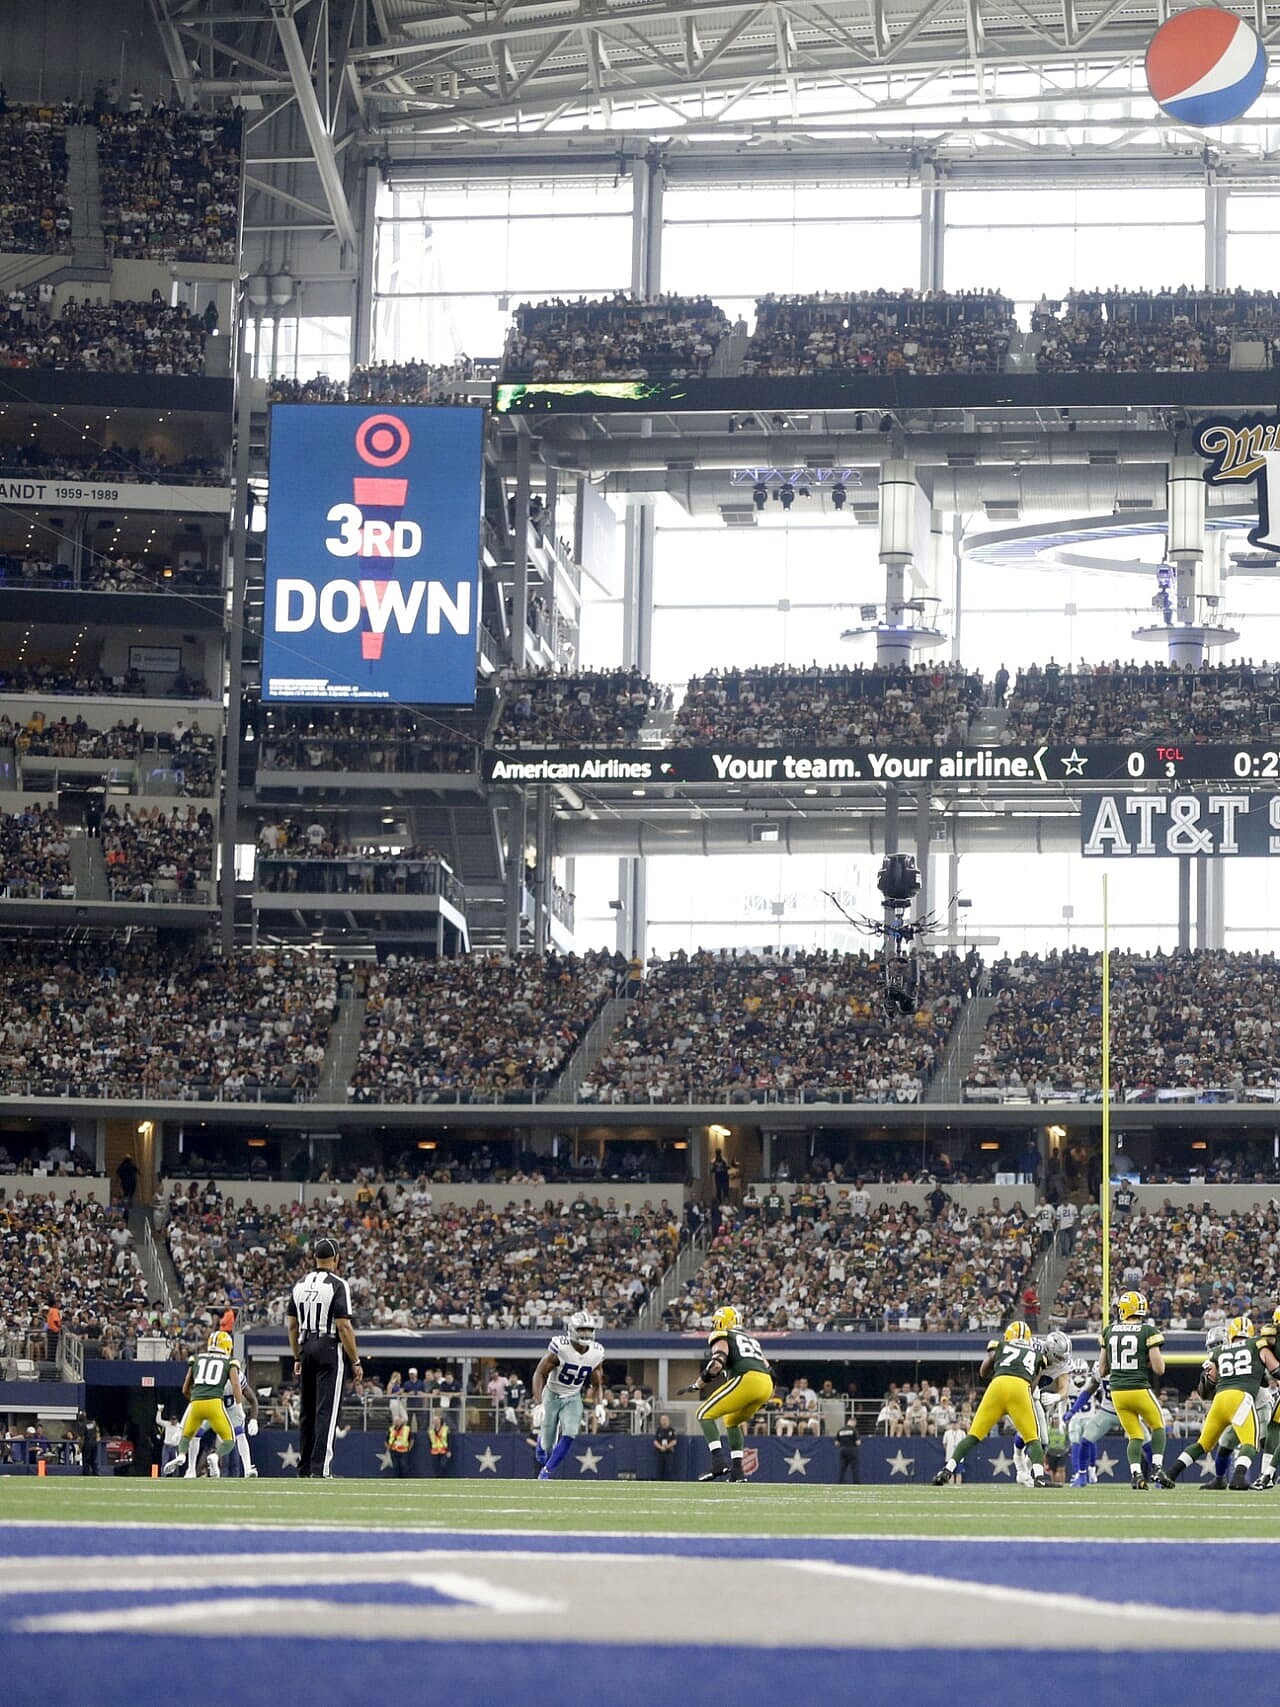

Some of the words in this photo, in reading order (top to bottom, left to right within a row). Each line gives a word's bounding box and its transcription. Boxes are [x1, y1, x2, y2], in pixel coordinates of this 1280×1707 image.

[55, 488, 119, 500] 1959-1989
[325, 503, 422, 558] 3RD
[275, 578, 471, 635] DOWN
[491, 759, 580, 779] American
[581, 759, 652, 778] Airlines
[712, 754, 777, 779] Your
[783, 754, 861, 778] team.
[868, 753, 933, 778] Your
[939, 751, 1034, 778] airline.
[1127, 752, 1145, 777] 0
[1165, 762, 1176, 777] 3
[1084, 796, 1250, 854] AT&T
[304, 1290, 319, 1302] 77
[1000, 1345, 1036, 1376] 74
[1109, 1335, 1138, 1370] 12
[1218, 1349, 1252, 1377] 62
[194, 1358, 225, 1385] 10
